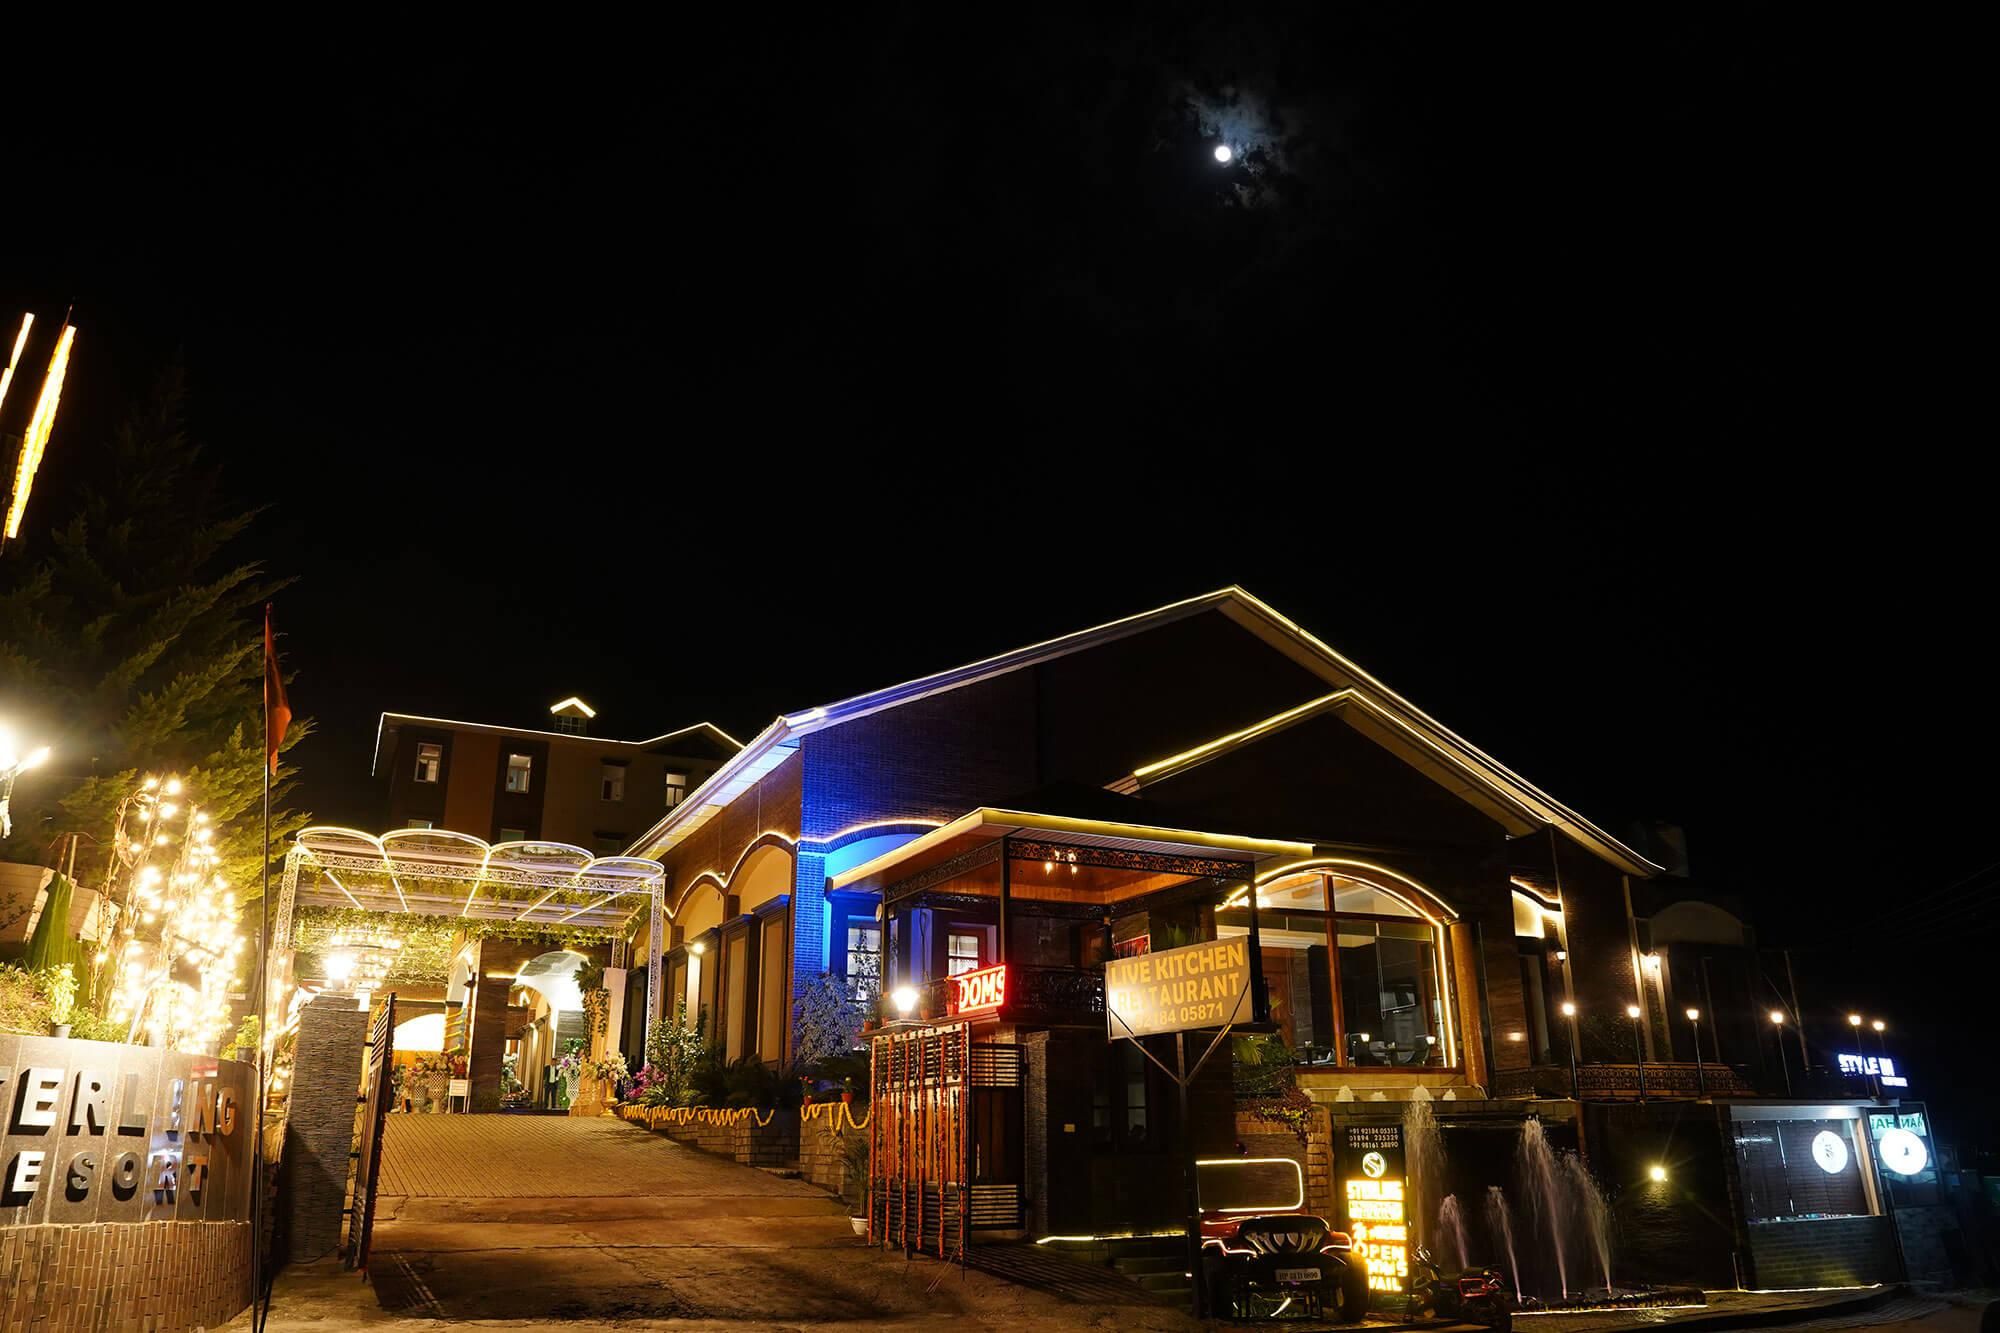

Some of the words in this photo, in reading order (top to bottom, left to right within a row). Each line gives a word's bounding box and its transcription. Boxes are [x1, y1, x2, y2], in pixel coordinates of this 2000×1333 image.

[1111, 960, 1152, 985] LIVE
[1154, 942, 1244, 981] KITCHEN
[1180, 1001, 1224, 1022] 05871
[1838, 1054, 1880, 1075] STYLE
[0, 1065, 238, 1138] ERLING
[1352, 1242, 1406, 1261] OPEN
